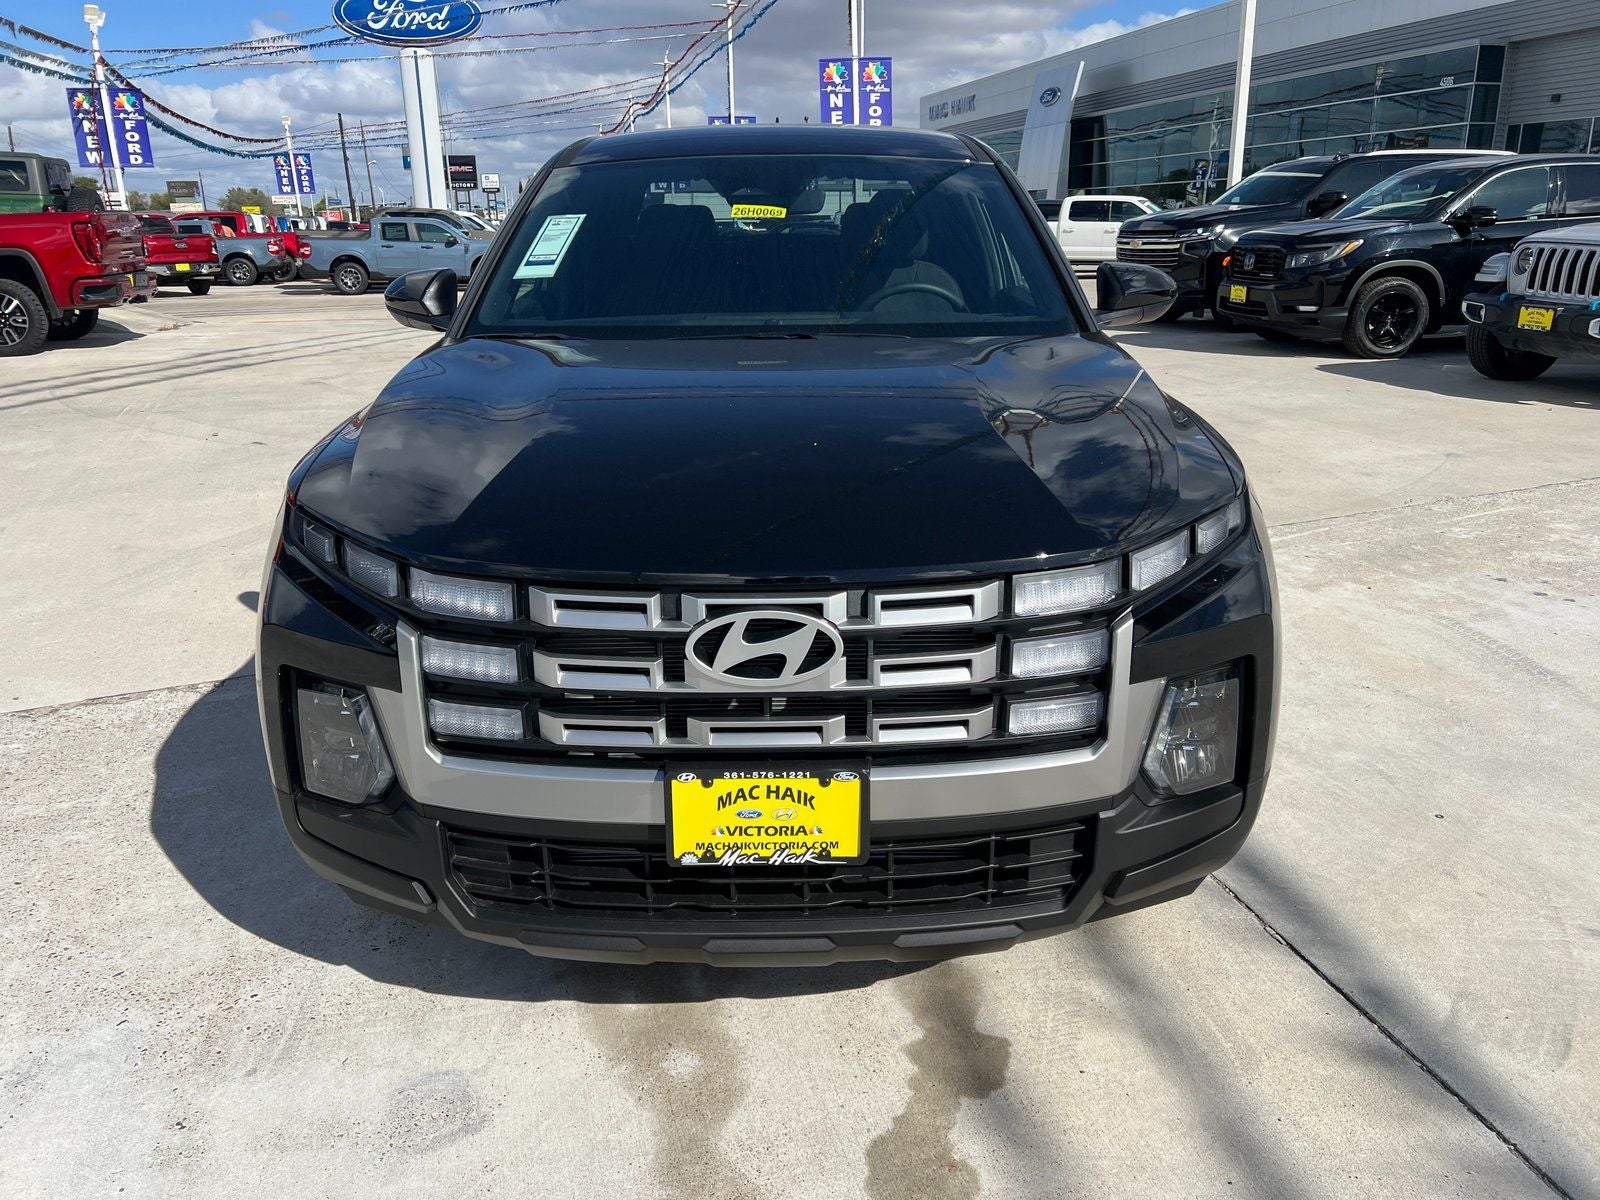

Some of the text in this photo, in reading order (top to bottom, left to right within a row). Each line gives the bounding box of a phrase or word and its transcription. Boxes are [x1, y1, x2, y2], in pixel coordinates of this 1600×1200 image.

[366, 0, 451, 31] Ford
[82, 119, 104, 164] NEW
[124, 120, 143, 165] FORD
[280, 169, 291, 193] NEW
[300, 169, 311, 193] FORD
[733, 207, 783, 217] 26H0069
[723, 771, 811, 779] 361-576-1221
[717, 785, 816, 811] MAC HAIK
[725, 825, 809, 837] VICTORIA
[695, 841, 839, 850] MACHAIKVICTORIA.COM
[719, 847, 820, 867] Mac Haik
